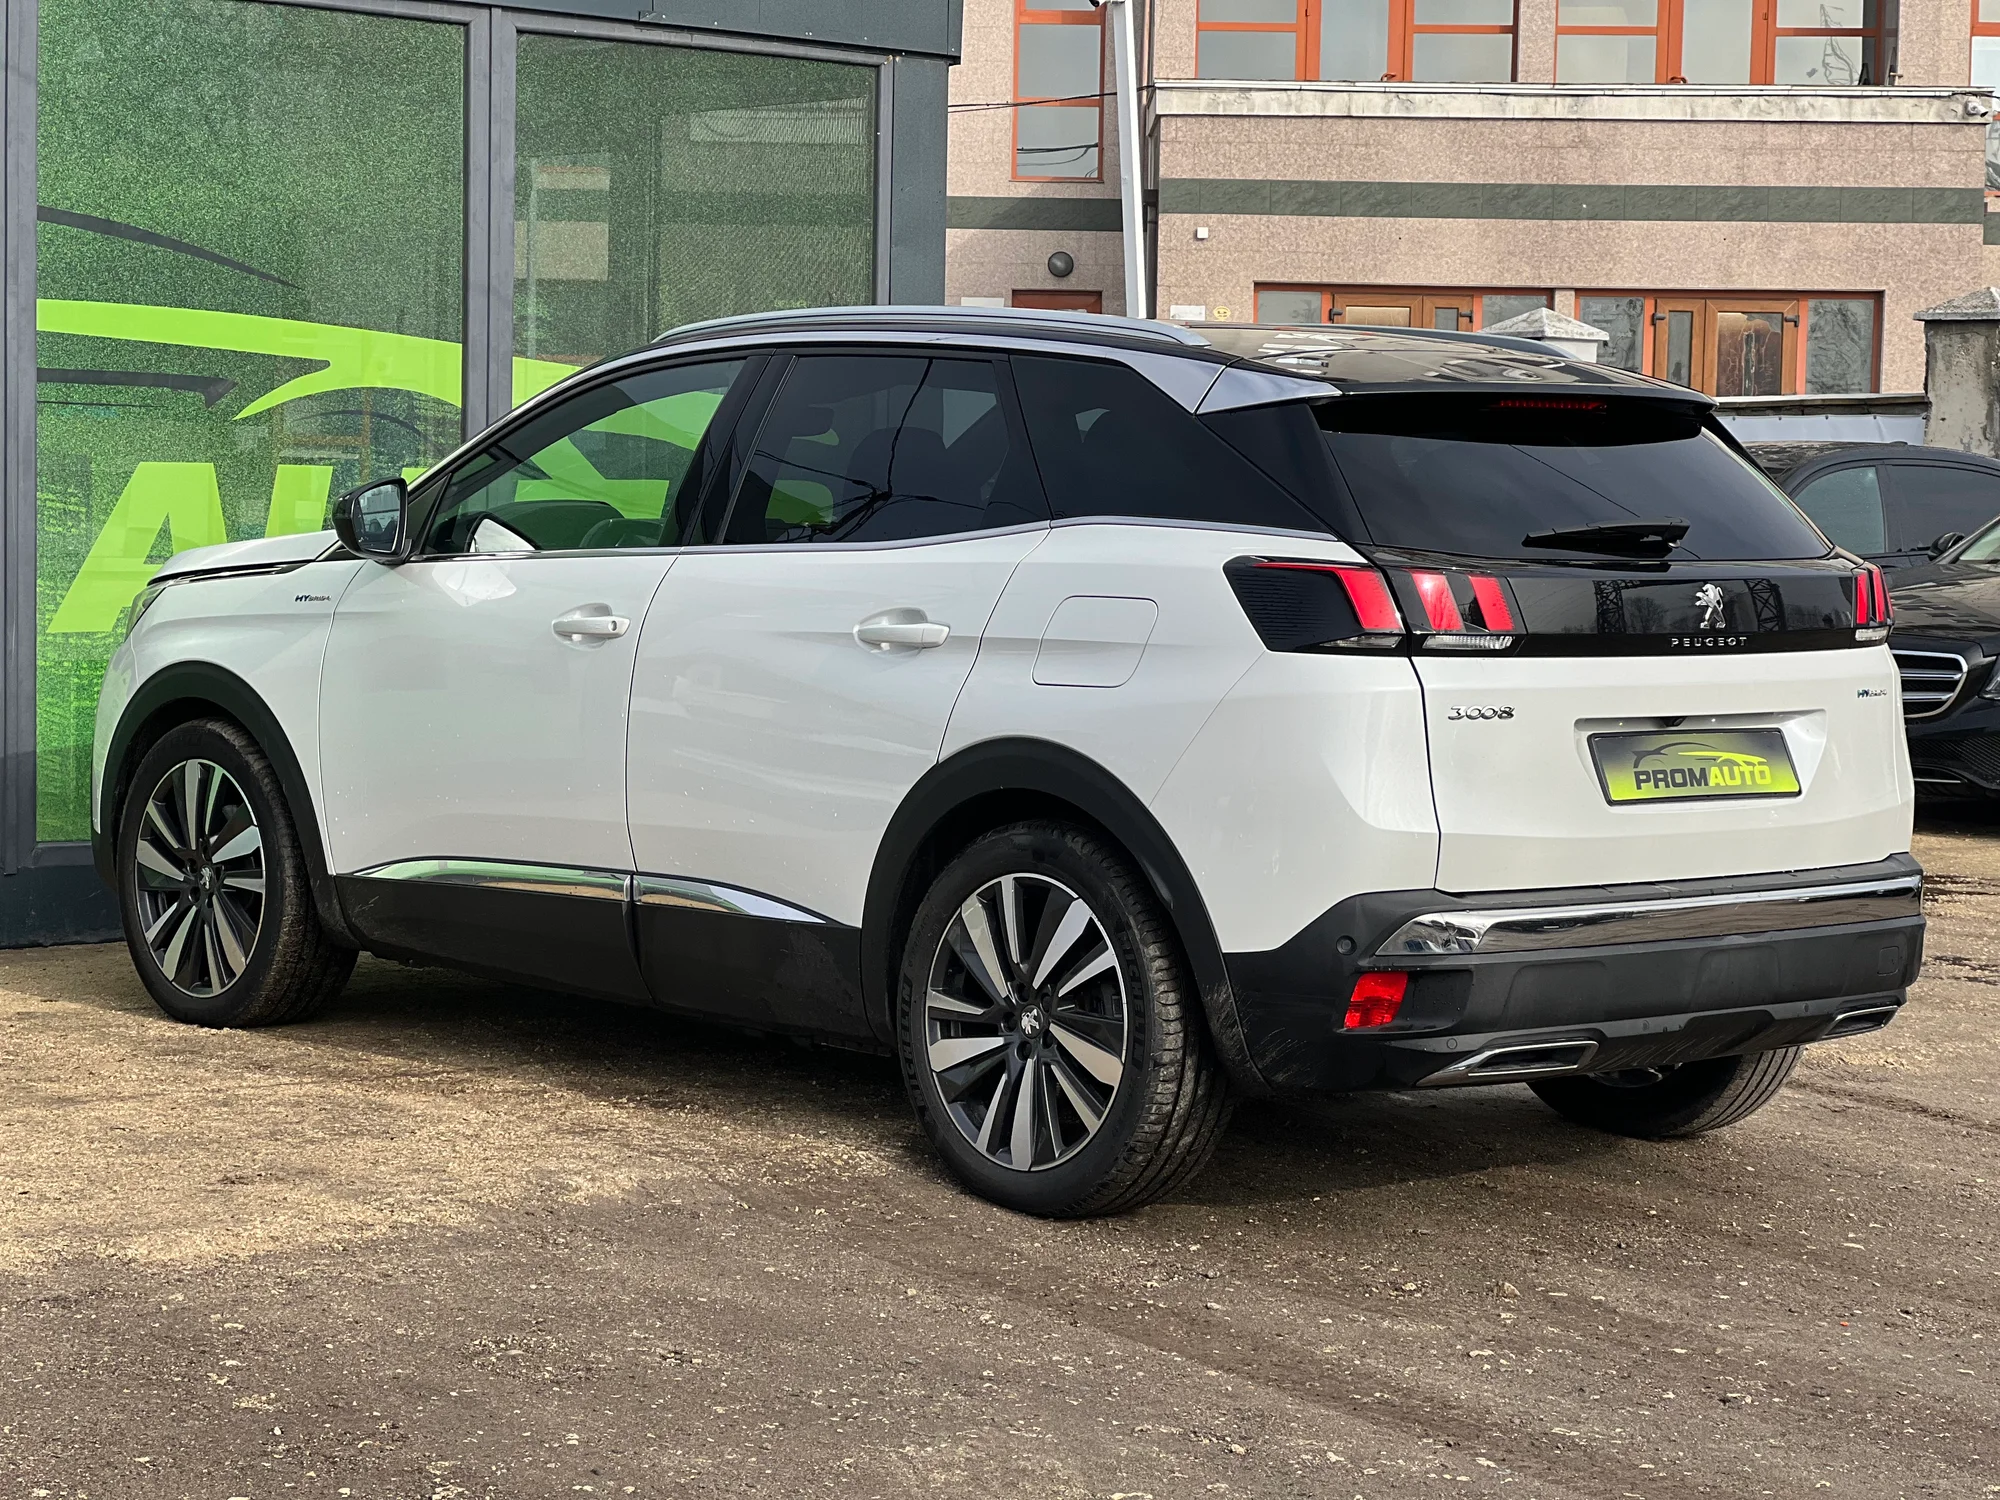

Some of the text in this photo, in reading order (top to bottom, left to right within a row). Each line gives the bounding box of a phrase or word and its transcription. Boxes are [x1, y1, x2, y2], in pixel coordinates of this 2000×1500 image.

[1670, 636, 1748, 648] PEUGEOT
[1447, 705, 1515, 720] 3008
[1633, 764, 1773, 791] PROMAUTO
